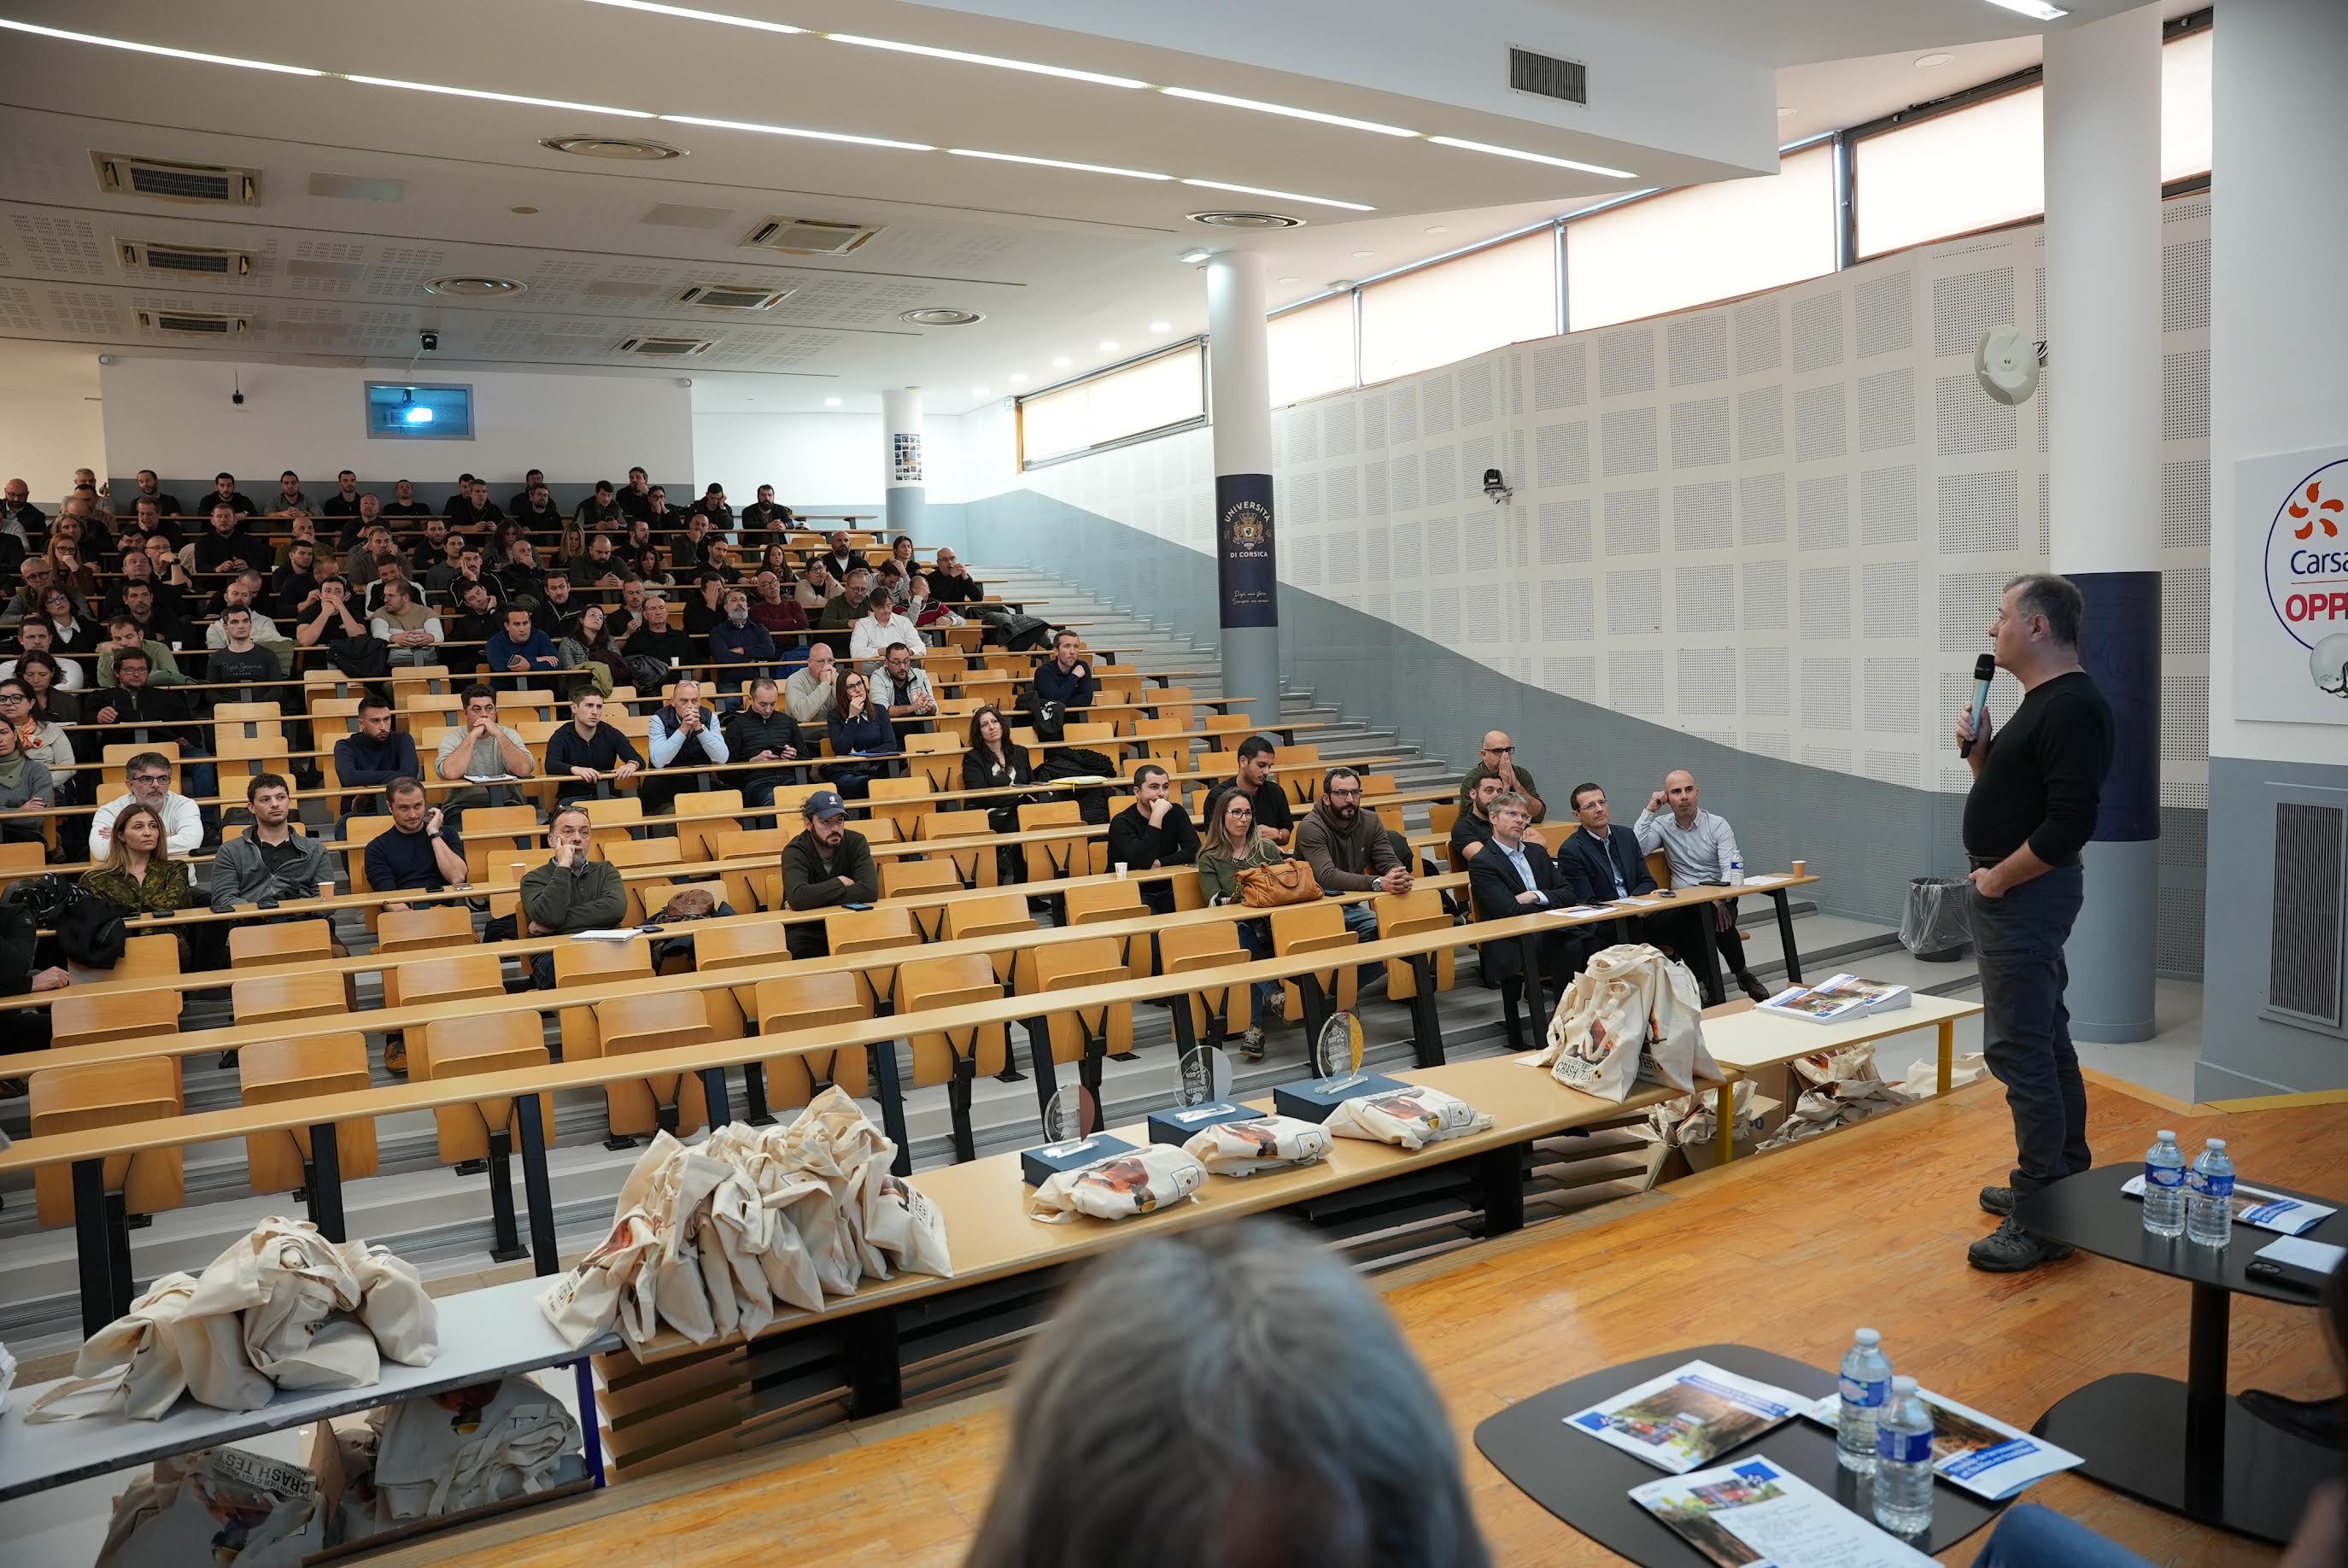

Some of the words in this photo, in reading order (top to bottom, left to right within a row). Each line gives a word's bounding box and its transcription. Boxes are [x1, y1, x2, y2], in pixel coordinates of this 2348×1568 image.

[1224, 501, 1271, 523] UNIVERSITÀ
[2286, 592, 2348, 622] OPP
[1556, 1062, 1578, 1079] CRASH
[259, 1466, 311, 1495] CRASH
